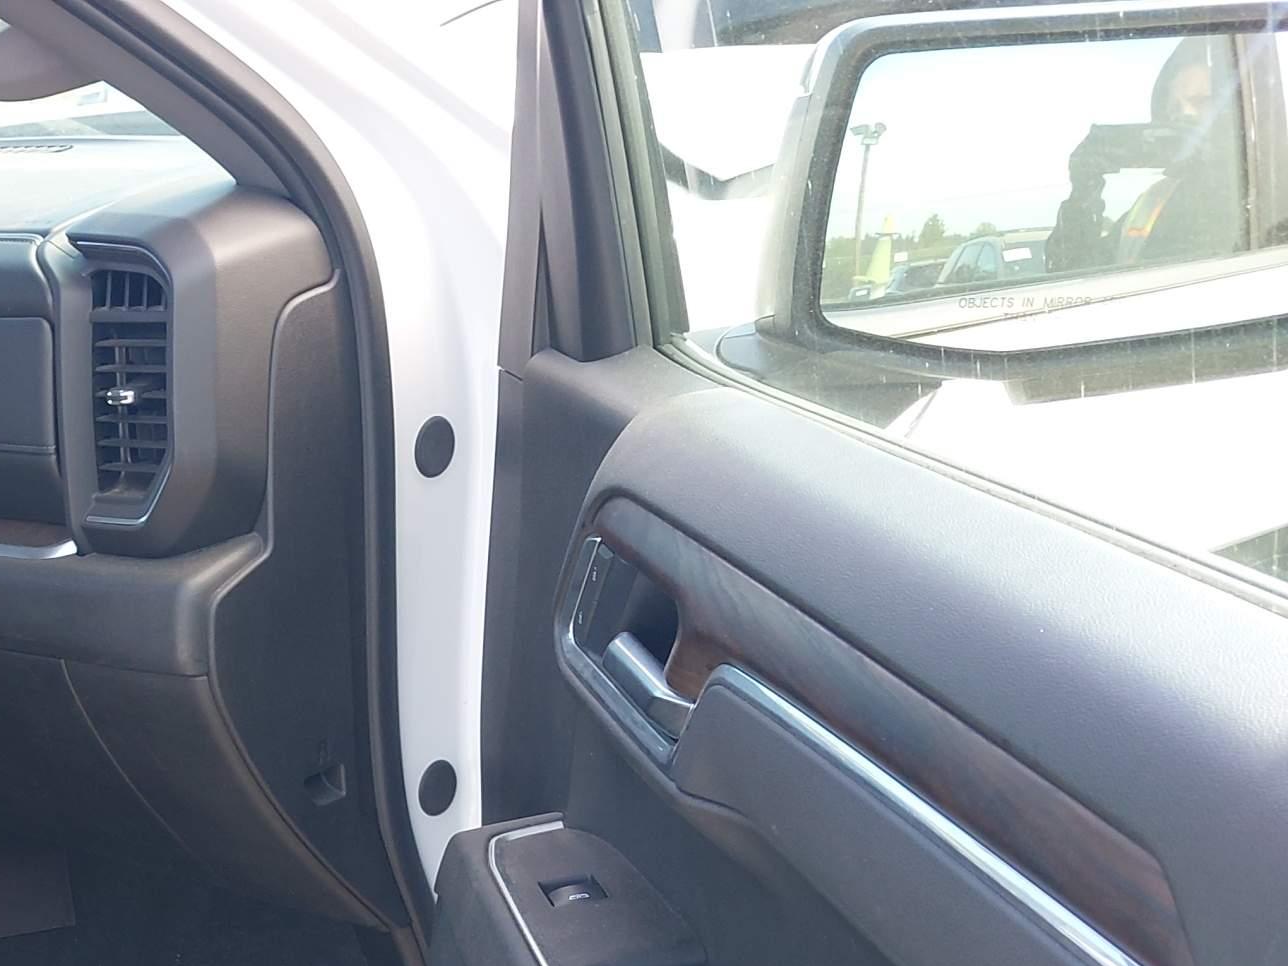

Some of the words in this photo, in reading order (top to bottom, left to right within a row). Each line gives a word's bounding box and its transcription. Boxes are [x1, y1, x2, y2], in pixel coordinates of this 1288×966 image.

[958, 296, 1015, 309] OBJECTS
[1022, 297, 1035, 308] IN
[1043, 296, 1092, 309] MIRROR
